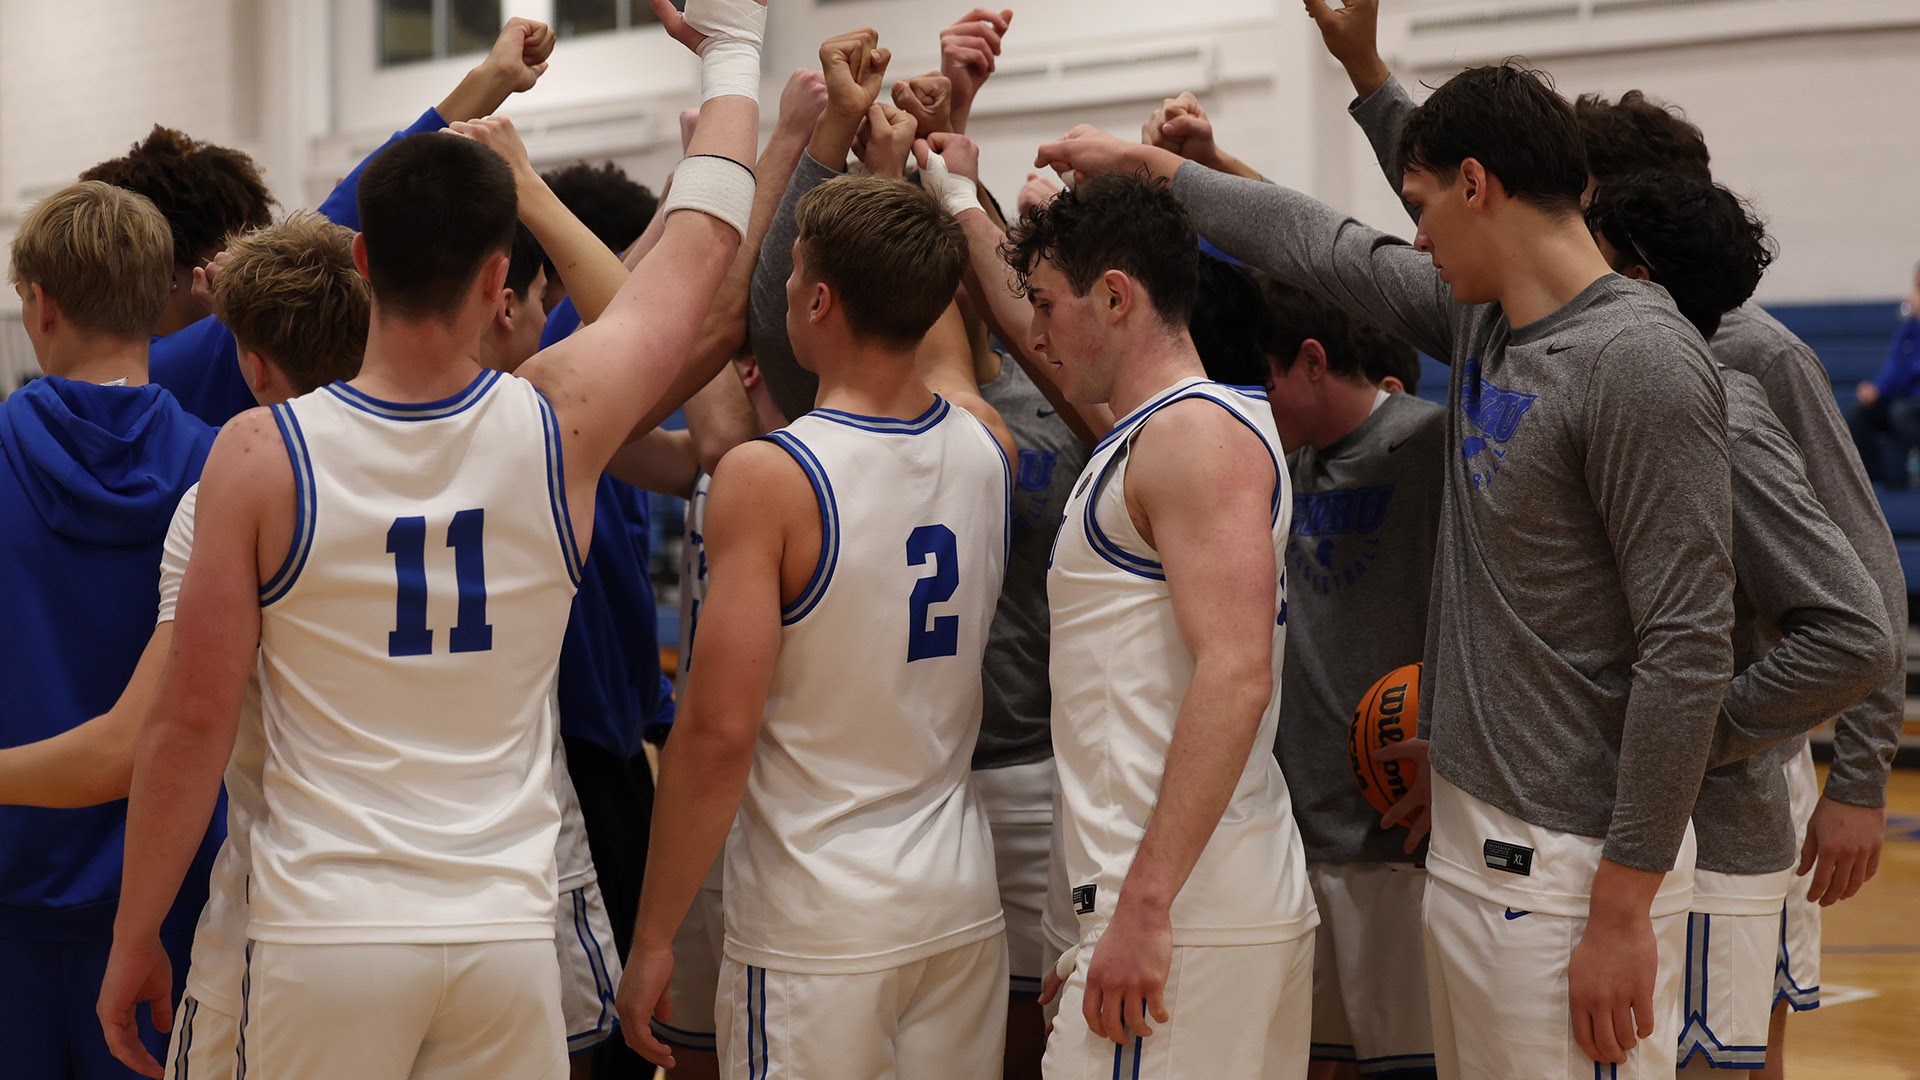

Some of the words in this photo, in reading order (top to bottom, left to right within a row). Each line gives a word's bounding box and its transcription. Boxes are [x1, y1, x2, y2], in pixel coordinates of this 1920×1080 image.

[386, 508, 493, 657] 11
[906, 524, 959, 663] 2
[1378, 683, 1408, 799] Wilon
[1513, 854, 1524, 866] XL
